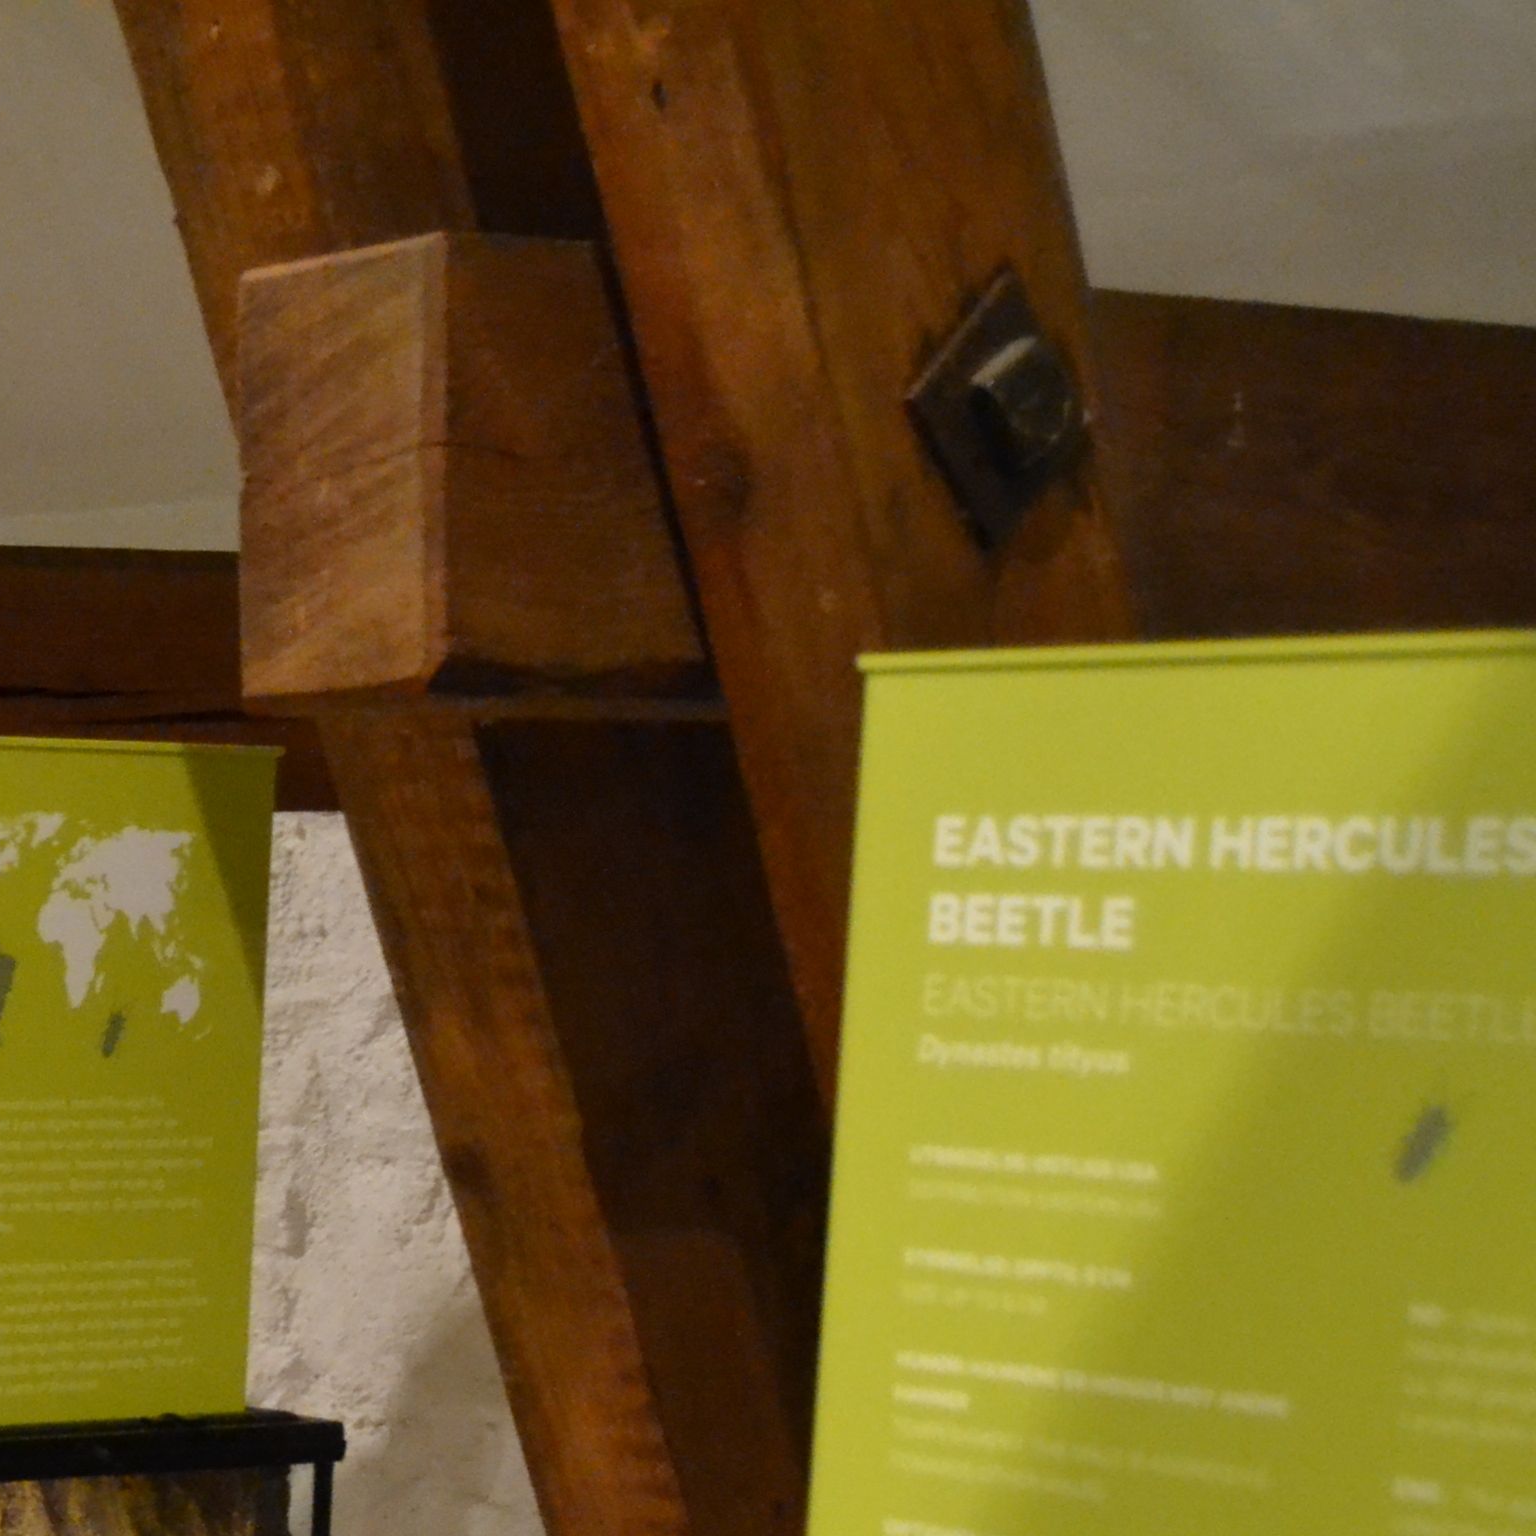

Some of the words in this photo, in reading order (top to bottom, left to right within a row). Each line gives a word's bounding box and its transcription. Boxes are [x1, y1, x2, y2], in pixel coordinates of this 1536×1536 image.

[933, 814, 1196, 869] EASTERN
[1209, 816, 1536, 876] HERCULES
[928, 893, 1135, 951] BEETLE
[923, 972, 1111, 1022] EASTERN
